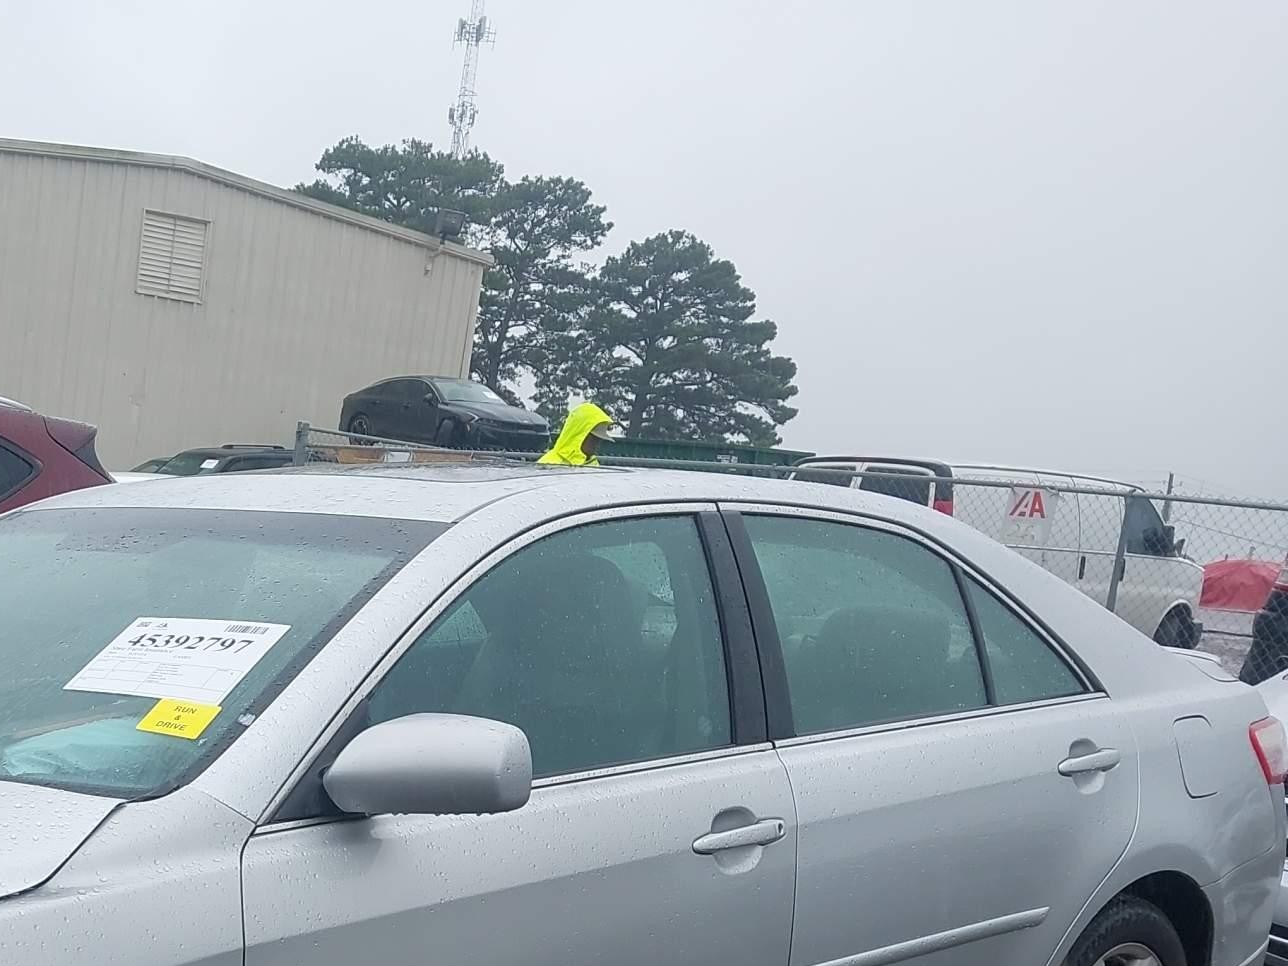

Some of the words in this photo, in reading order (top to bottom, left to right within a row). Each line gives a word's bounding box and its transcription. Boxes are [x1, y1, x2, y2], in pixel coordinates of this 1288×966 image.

[128, 633, 255, 654] 45392797
[173, 705, 198, 714] RUN
[155, 720, 189, 731] DRIVE
